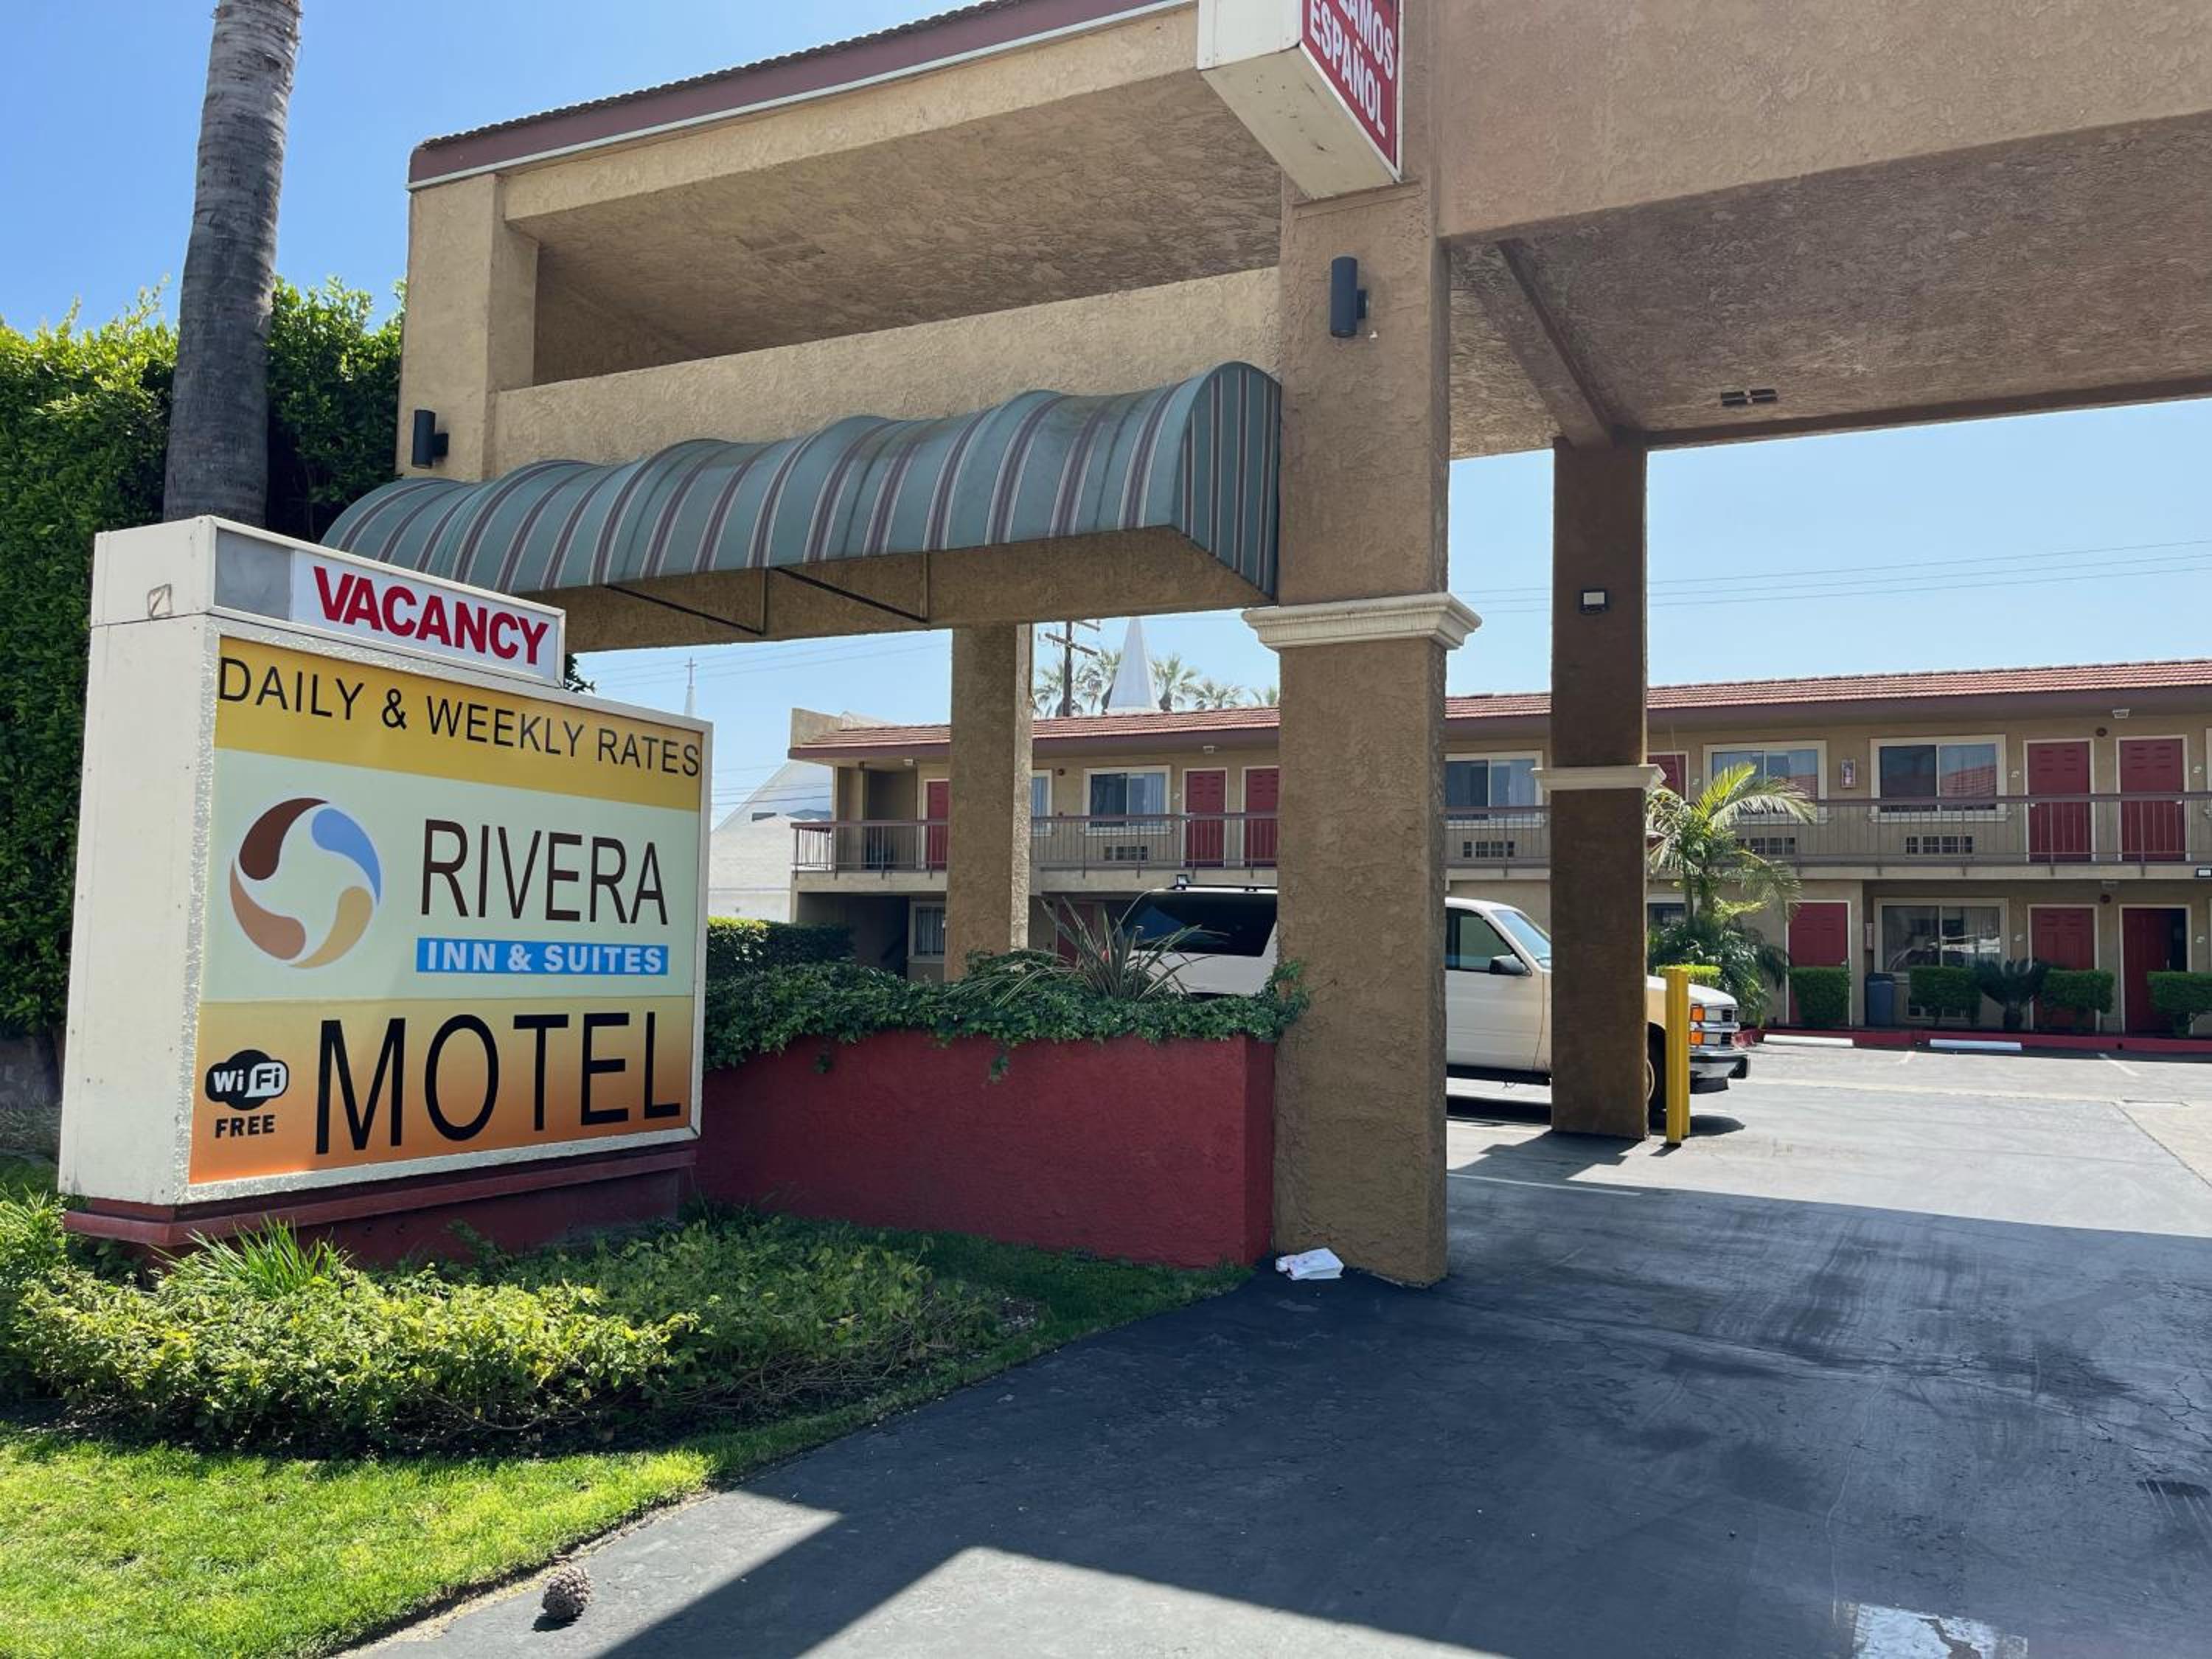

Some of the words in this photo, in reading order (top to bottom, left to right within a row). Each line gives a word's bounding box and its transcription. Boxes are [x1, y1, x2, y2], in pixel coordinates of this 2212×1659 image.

[1310, 0, 1385, 138] ESPAÑOL
[313, 567, 549, 664] VACANCY
[219, 657, 364, 720] DAILY
[381, 689, 407, 728] &
[427, 696, 585, 758] WEEKLY
[597, 729, 700, 777] RATES
[421, 819, 669, 925] RIVERA
[427, 942, 495, 971] INN
[509, 942, 532, 972] &
[543, 946, 662, 974] SUITES
[215, 1115, 275, 1138] FREE
[315, 1011, 681, 1155] MOTEL
